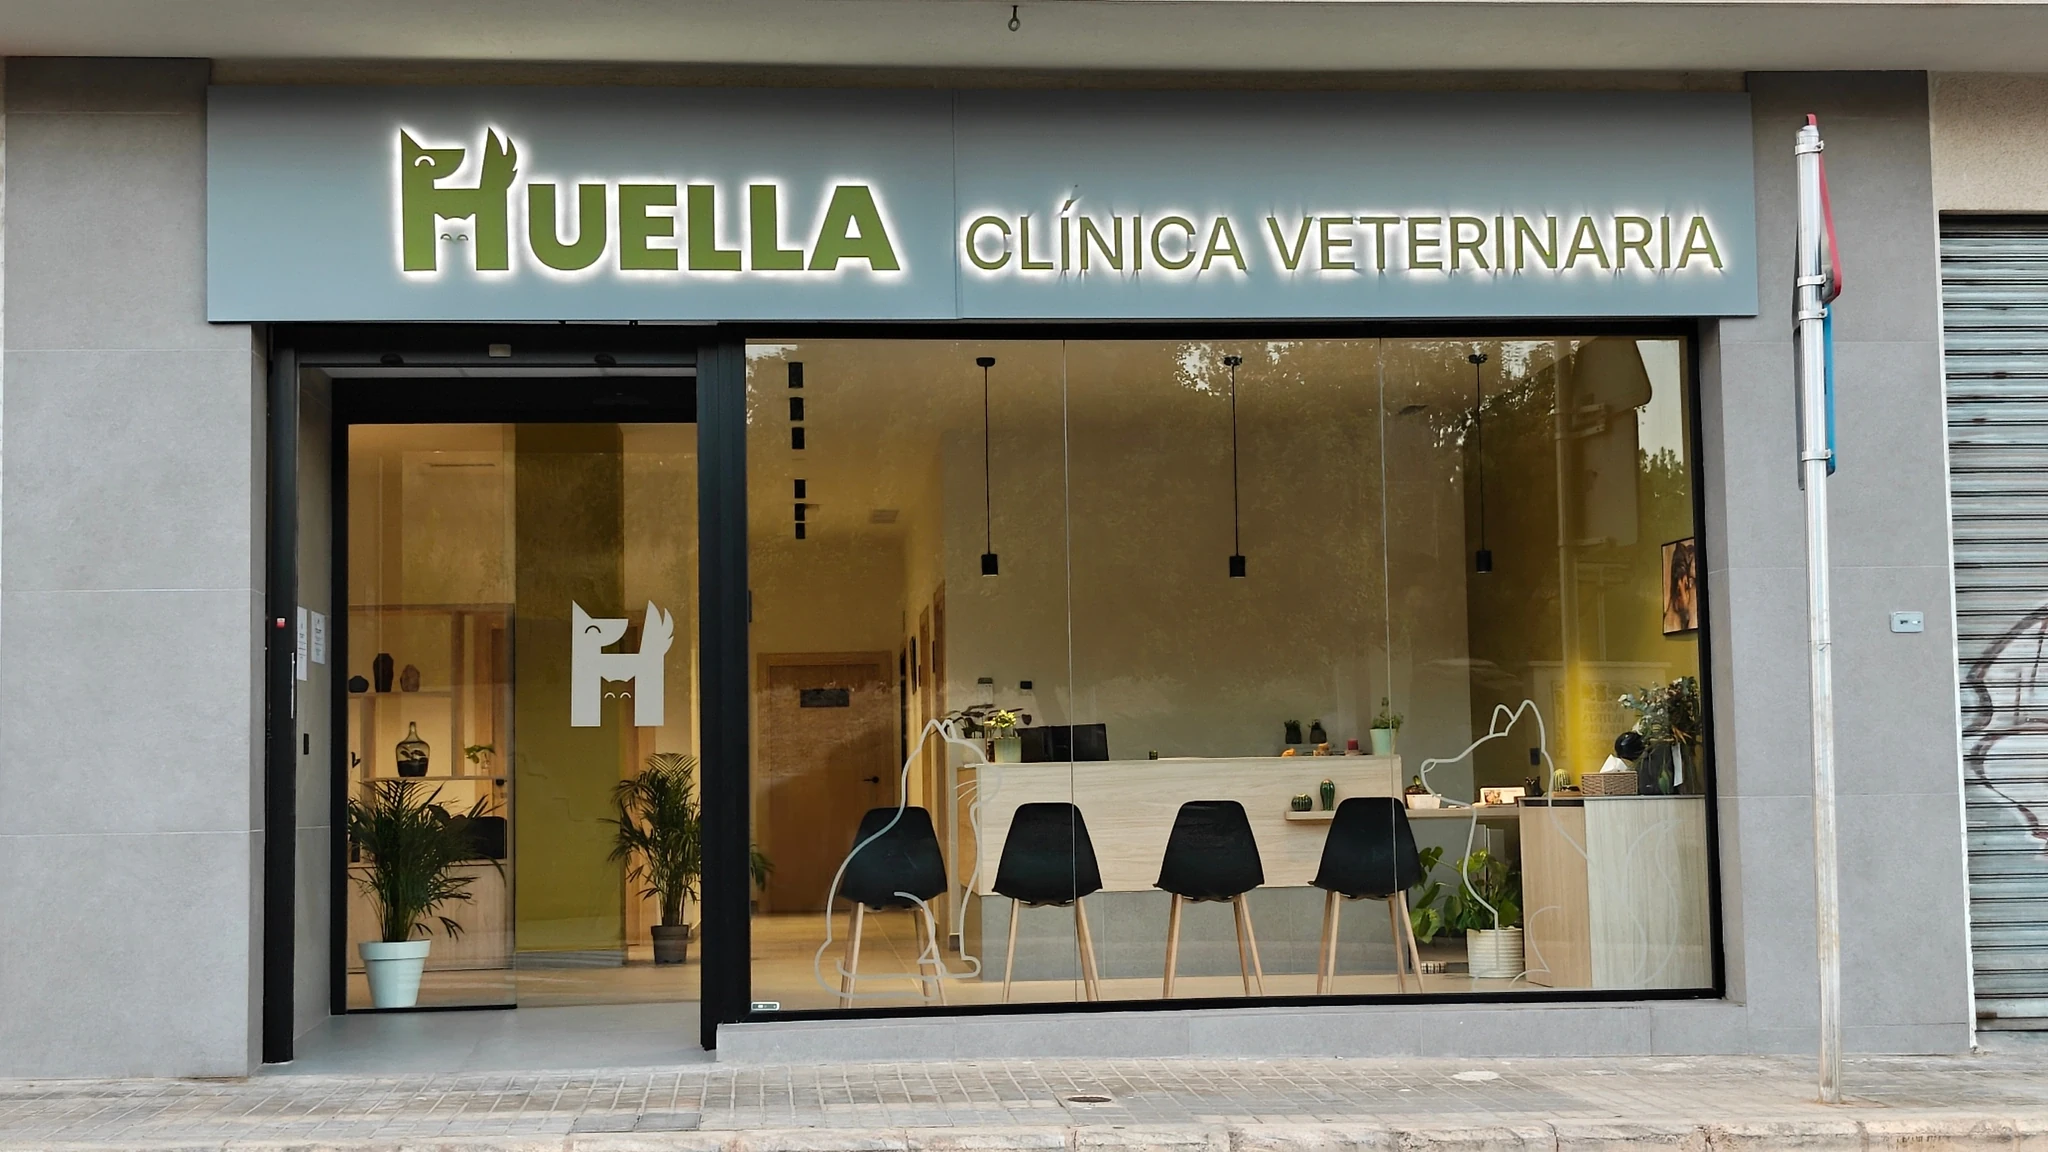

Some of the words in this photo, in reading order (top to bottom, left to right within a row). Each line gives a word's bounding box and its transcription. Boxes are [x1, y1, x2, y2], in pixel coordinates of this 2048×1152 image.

[400, 127, 901, 271] HUELLA
[965, 198, 1247, 271] CLÍNICA
[1267, 214, 1724, 271] VETERINARIA
